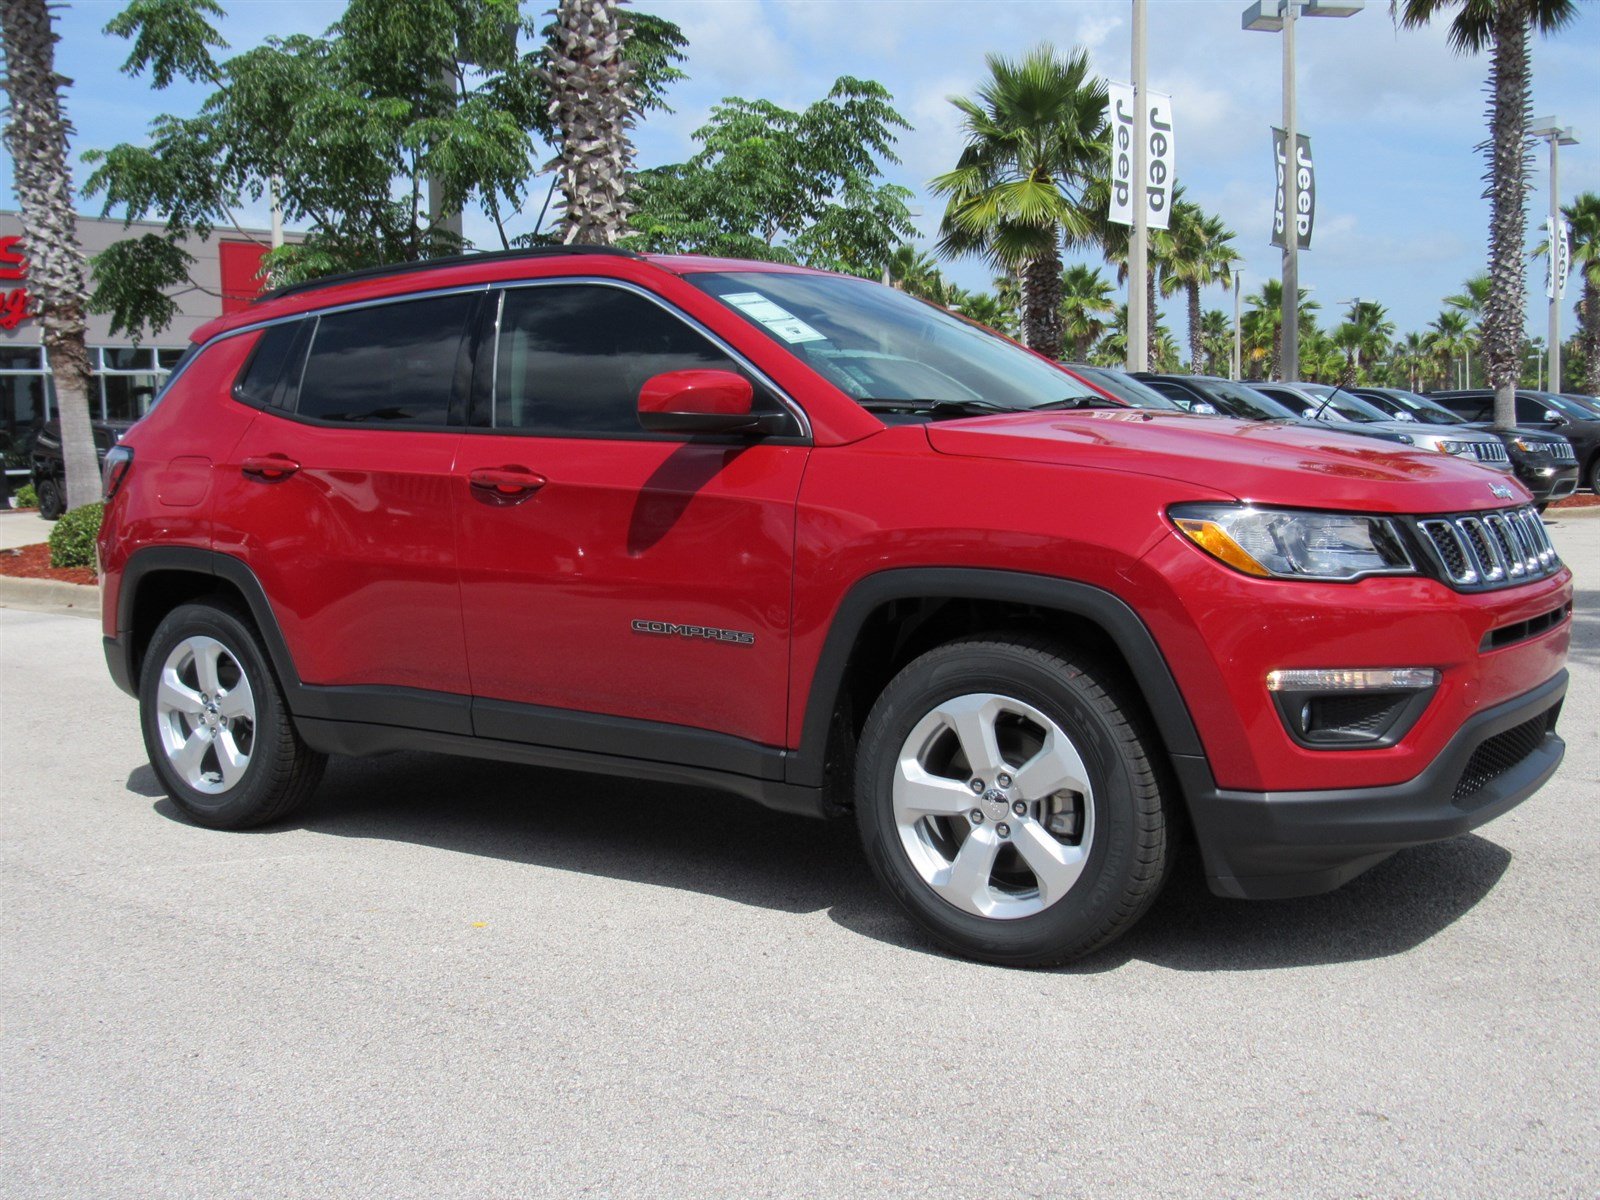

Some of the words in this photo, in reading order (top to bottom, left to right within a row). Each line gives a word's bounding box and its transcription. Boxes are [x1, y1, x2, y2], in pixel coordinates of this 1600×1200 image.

[1114, 98, 1133, 208] Jeep
[1146, 107, 1171, 213] Jeep
[1297, 146, 1313, 237] Jeep
[630, 618, 756, 645] COMPASS
